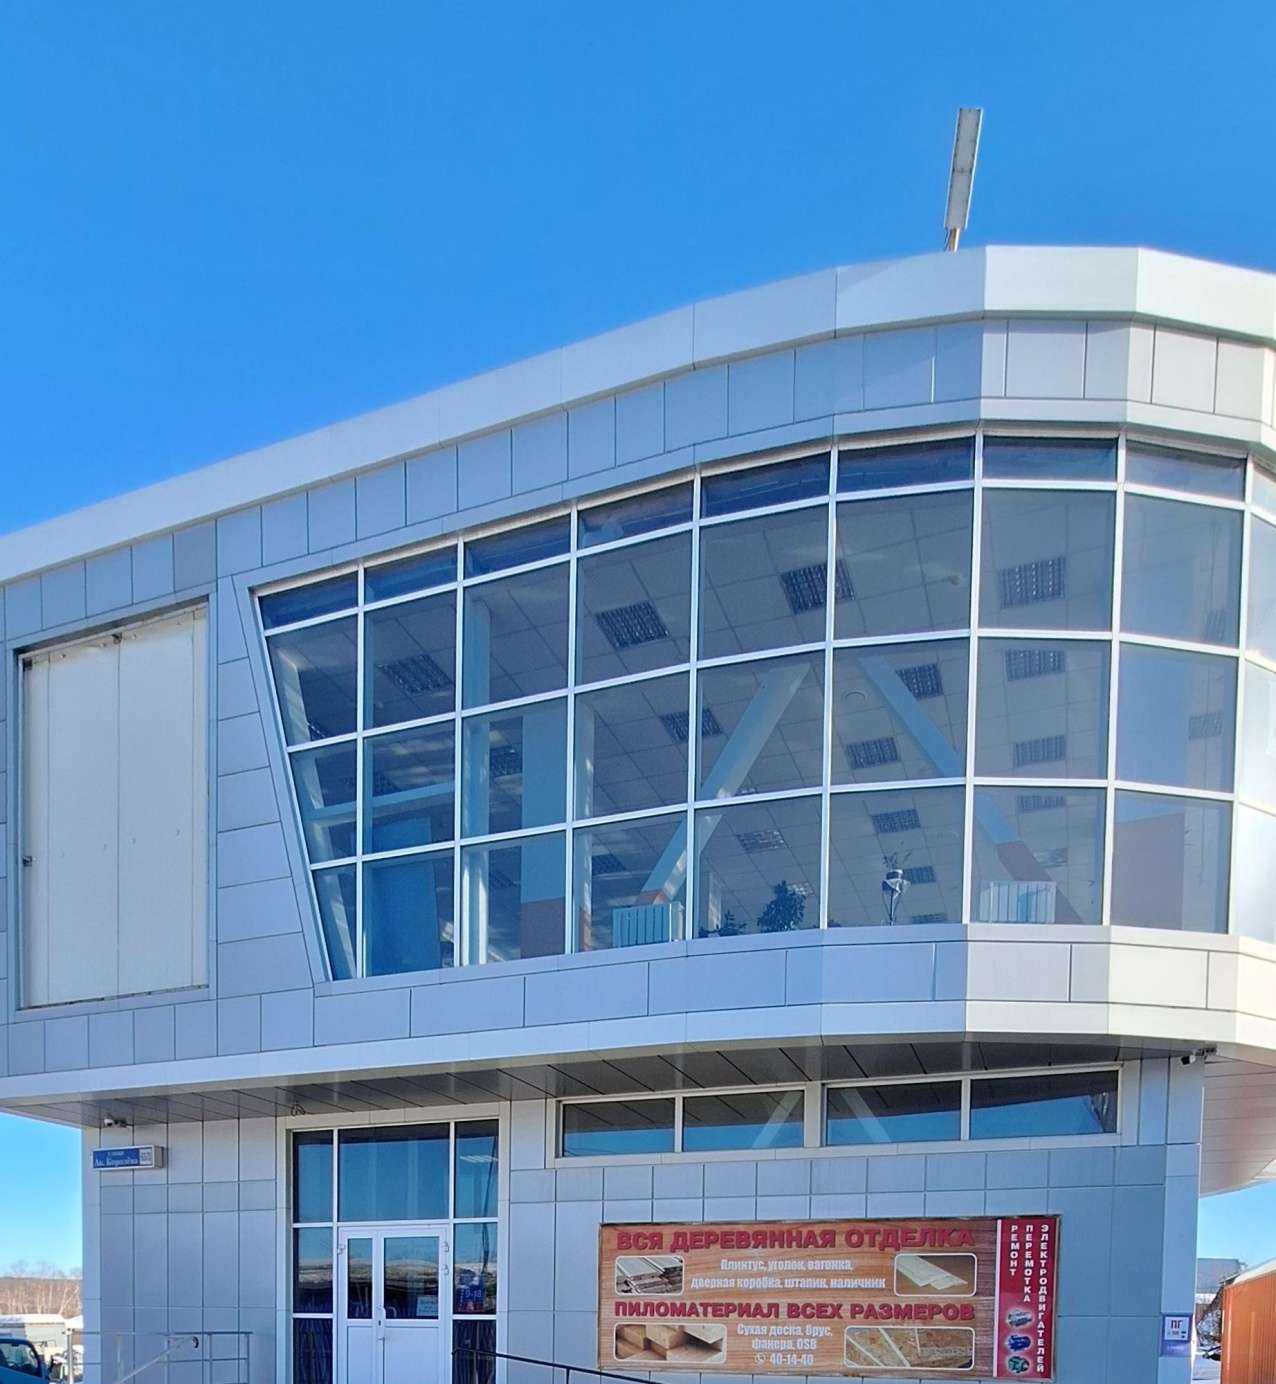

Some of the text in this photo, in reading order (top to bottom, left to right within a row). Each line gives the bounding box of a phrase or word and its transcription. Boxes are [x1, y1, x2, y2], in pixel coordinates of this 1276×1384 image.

[616, 1228, 976, 1253] ВСЯ ДЕРЕВЯННАЯ ОТДЕЛКА
[1009, 1224, 1020, 1276] РЕМОНТ
[1023, 1224, 1034, 1303] ПЕРЕМОТКА
[690, 1277, 735, 1289] дверная
[830, 1278, 886, 1289] наличник
[614, 1301, 976, 1321] ПИЛОМАТЕРИАЛ ВСЕХ РАЗМЕРОВ
[1036, 1224, 1049, 1373] ЭЛЕКТРОДВИГАТЕЛЕЙ
[736, 1323, 768, 1336] Сухая
